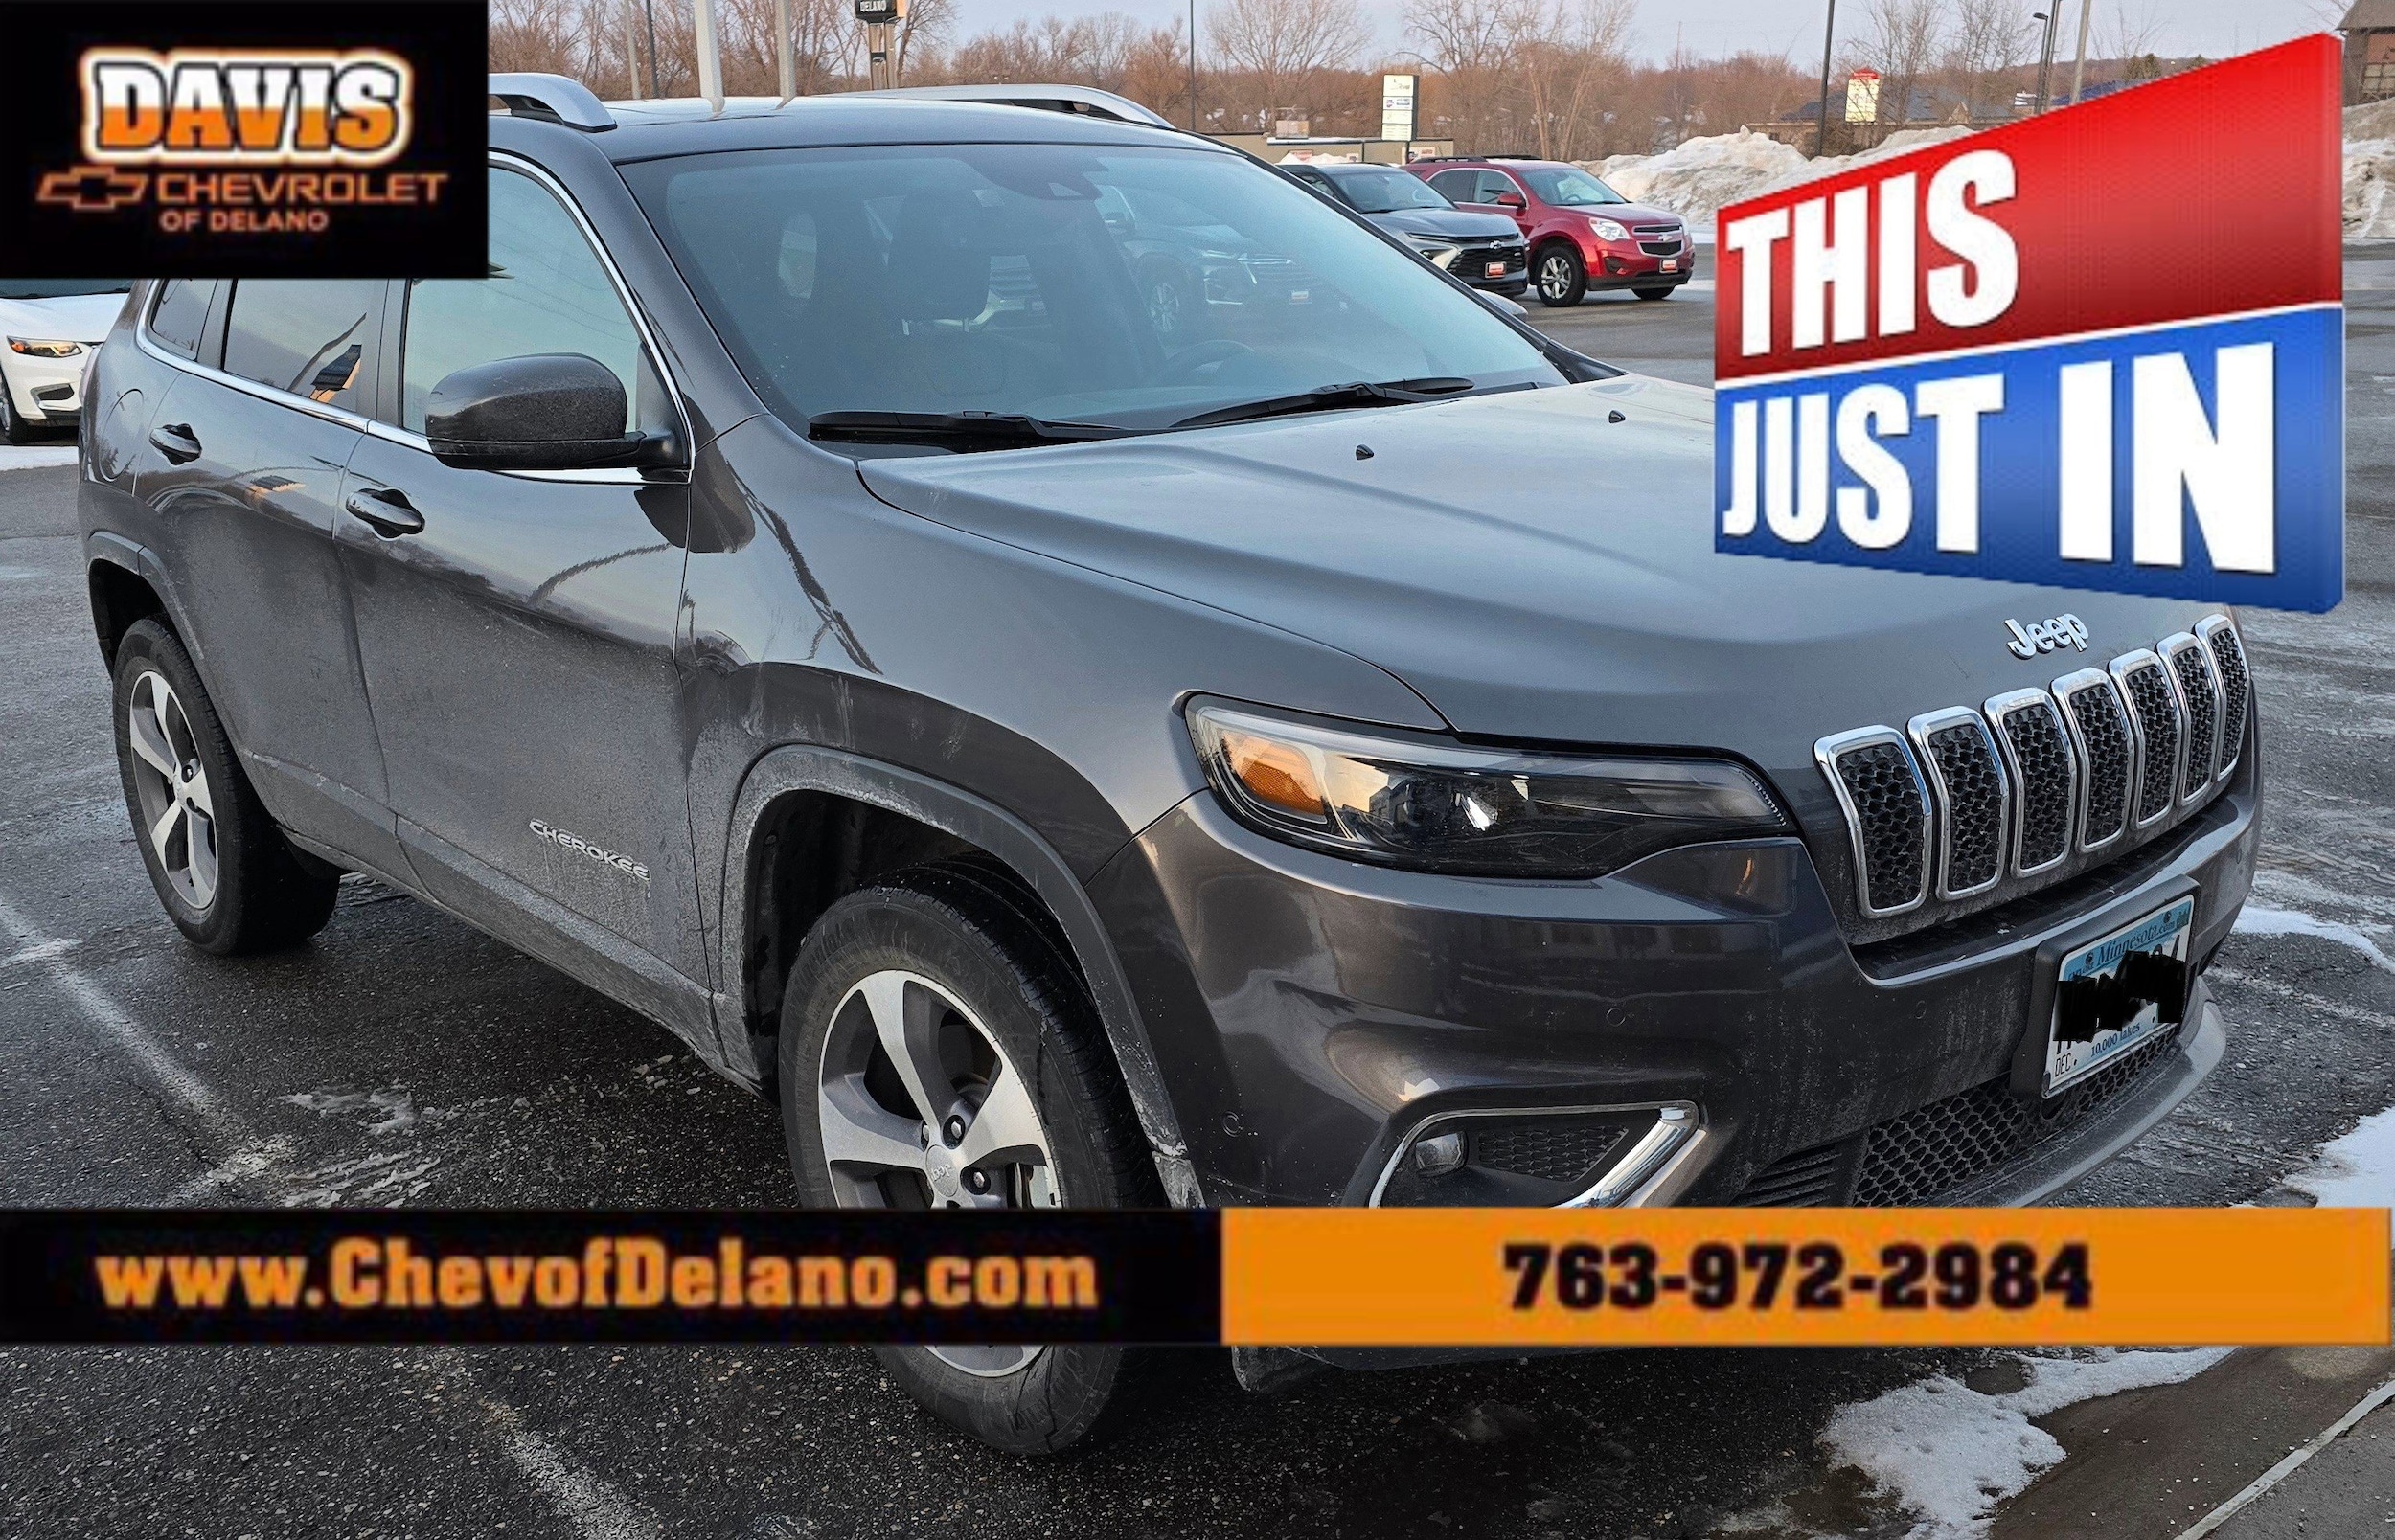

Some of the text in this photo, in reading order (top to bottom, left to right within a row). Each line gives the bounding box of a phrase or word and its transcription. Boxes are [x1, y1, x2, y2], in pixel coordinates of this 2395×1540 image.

[2004, 613, 2089, 660] Jeep
[528, 818, 651, 880] CHEROKEE
[2119, 1022, 2141, 1041] lakes
[2054, 1052, 2072, 1077] DEC
